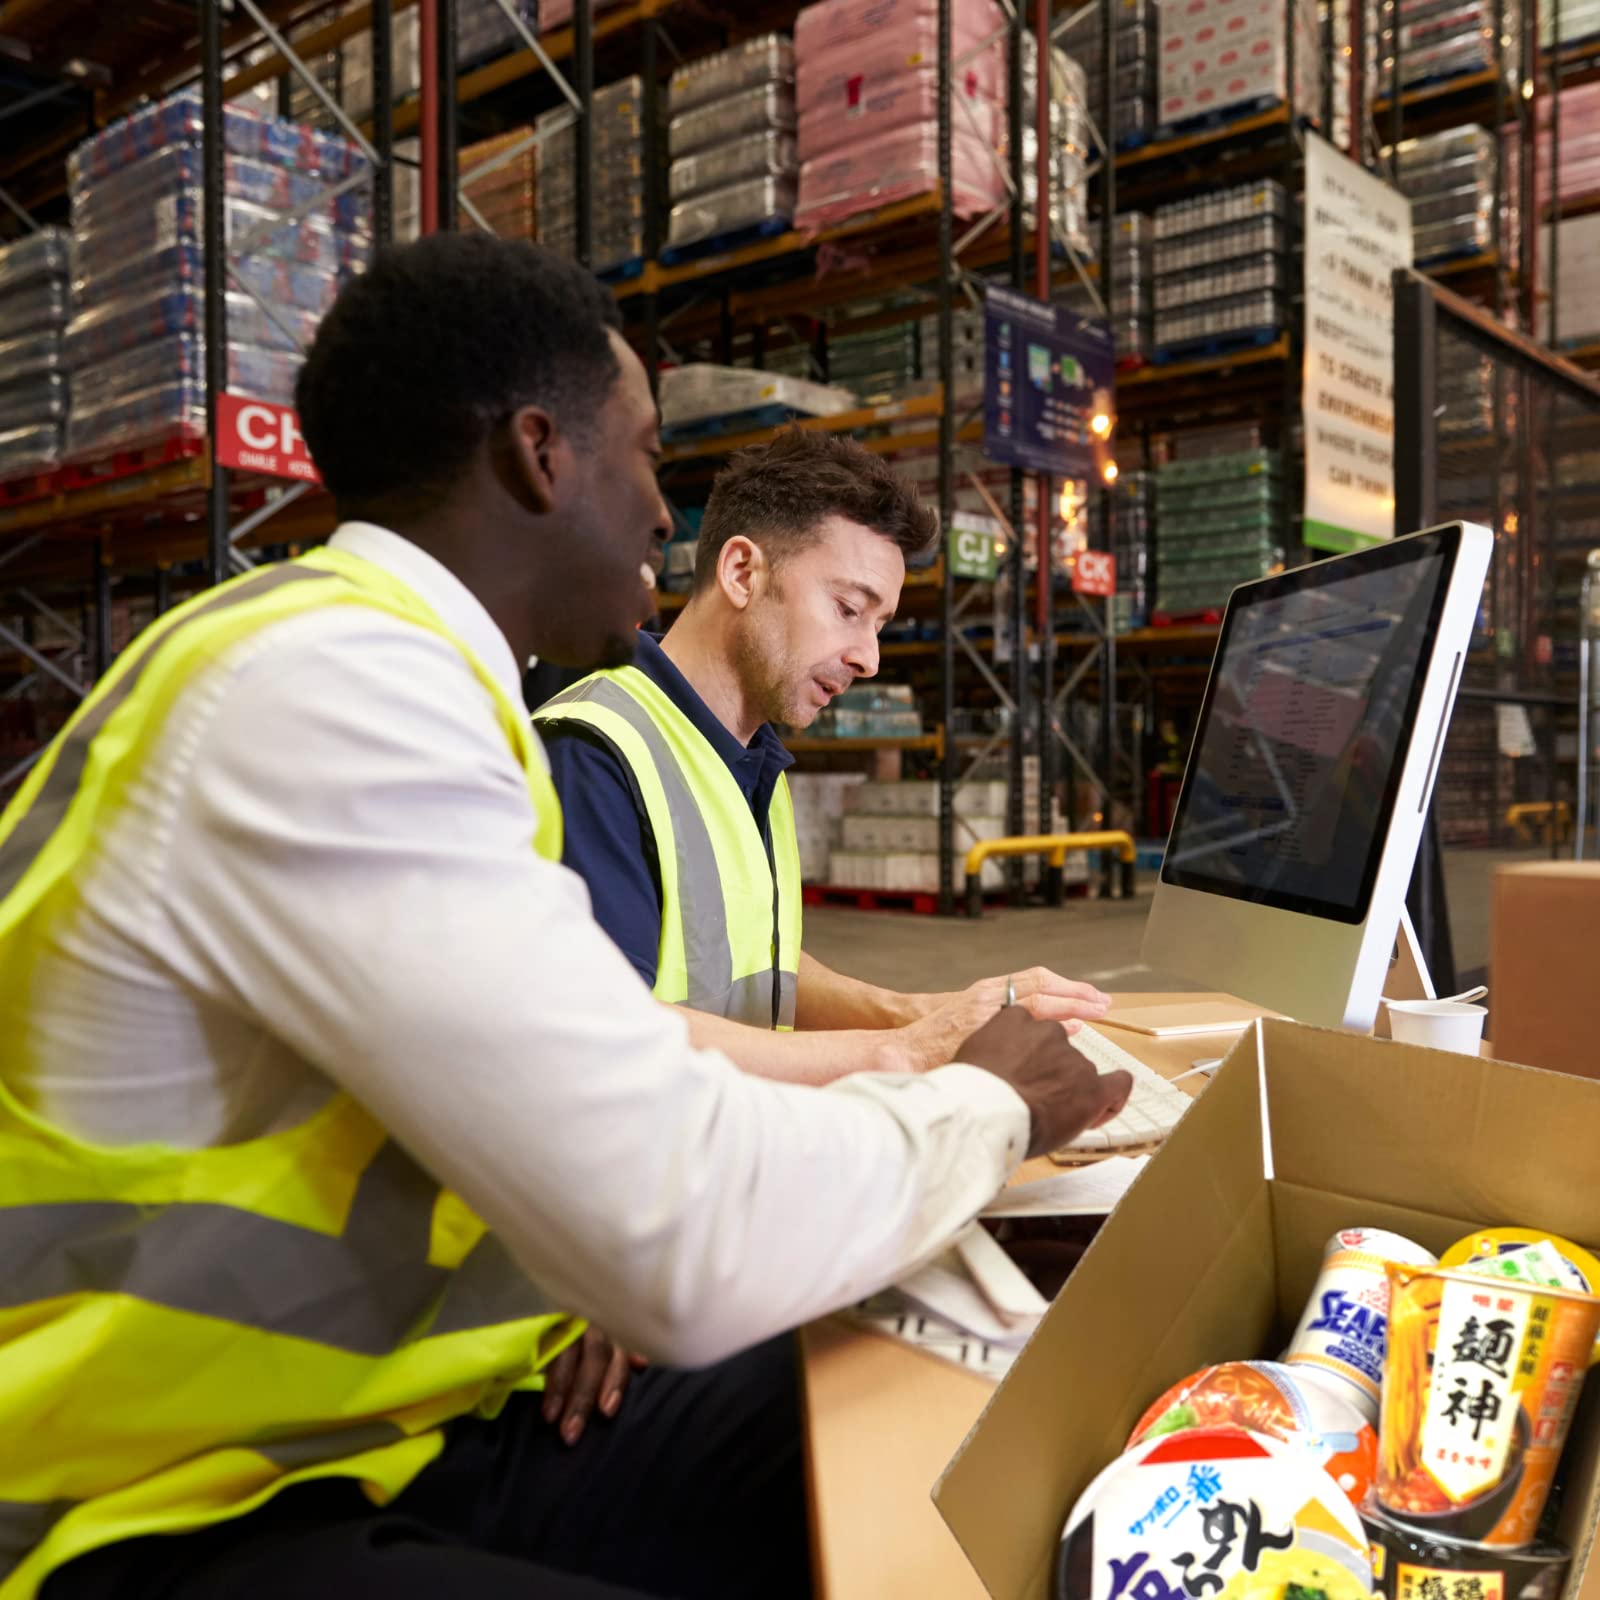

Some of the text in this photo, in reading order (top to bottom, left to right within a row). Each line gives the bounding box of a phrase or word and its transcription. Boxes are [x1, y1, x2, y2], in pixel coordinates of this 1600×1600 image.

[236, 405, 312, 459] CH
[958, 533, 989, 564] CJ
[1079, 553, 1111, 583] CK
[1307, 1290, 1388, 1356] SEAF
